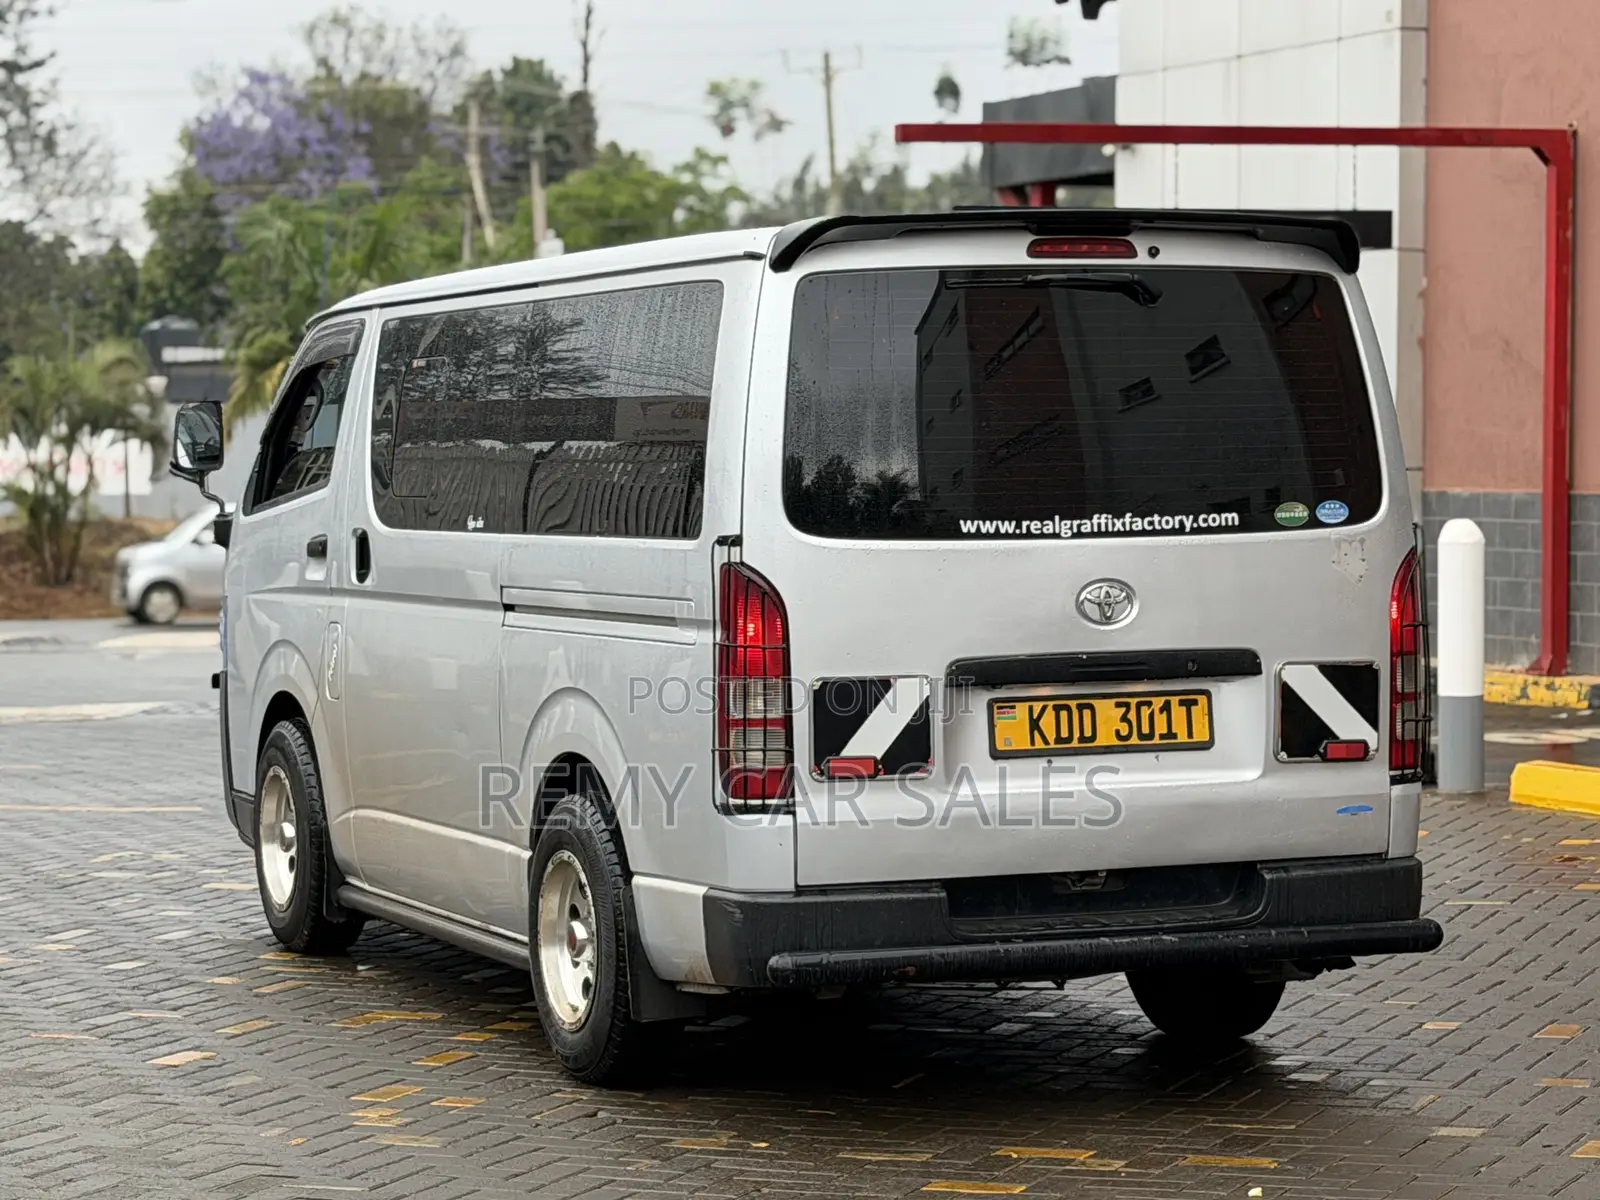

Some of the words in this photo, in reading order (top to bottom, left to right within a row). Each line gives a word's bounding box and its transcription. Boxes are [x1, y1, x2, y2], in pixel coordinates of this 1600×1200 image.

[959, 512, 1239, 537] www.realgraffixfactory.com
[1028, 703, 1098, 746] KDD
[1114, 699, 1199, 742] 301T
